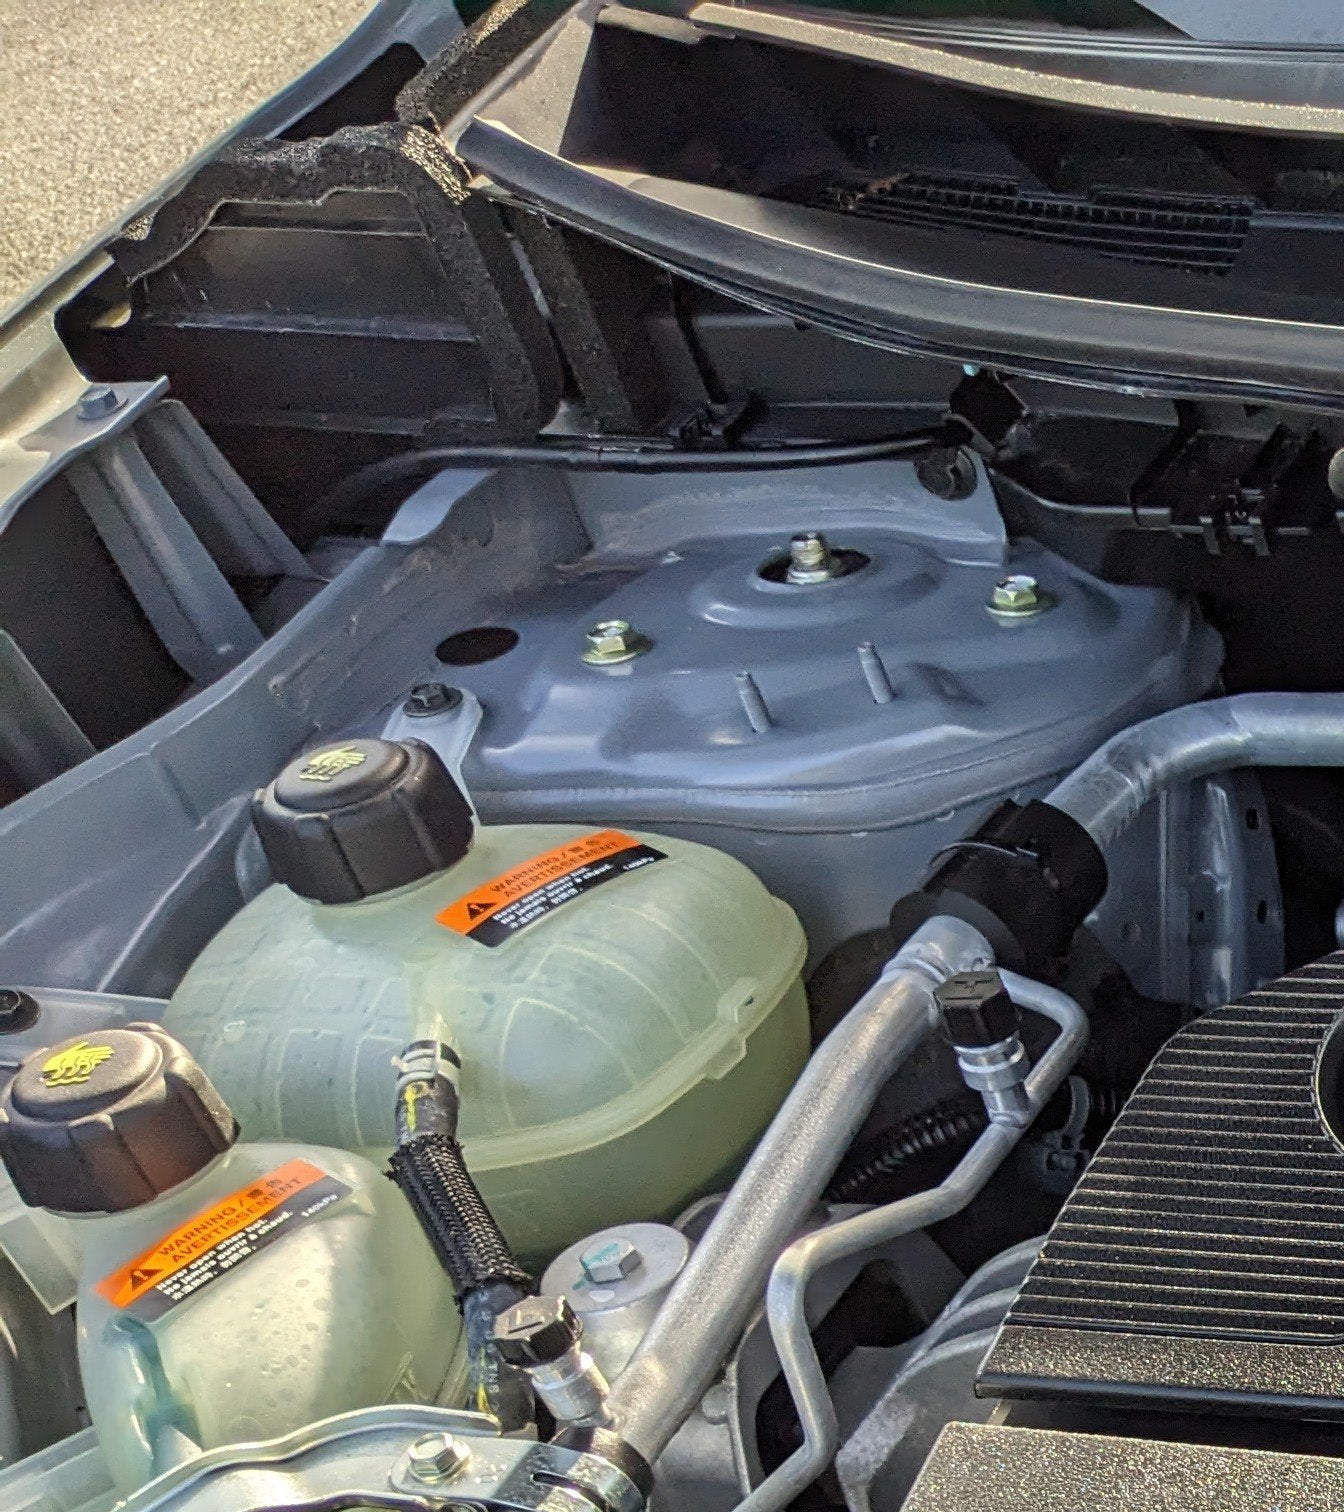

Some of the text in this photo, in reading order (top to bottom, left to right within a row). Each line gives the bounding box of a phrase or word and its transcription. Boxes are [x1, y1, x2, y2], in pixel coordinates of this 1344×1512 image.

[491, 856, 560, 893] WARNING
[159, 1206, 237, 1256] WARNING
[172, 1177, 302, 1264] AVERTISSEMENT
